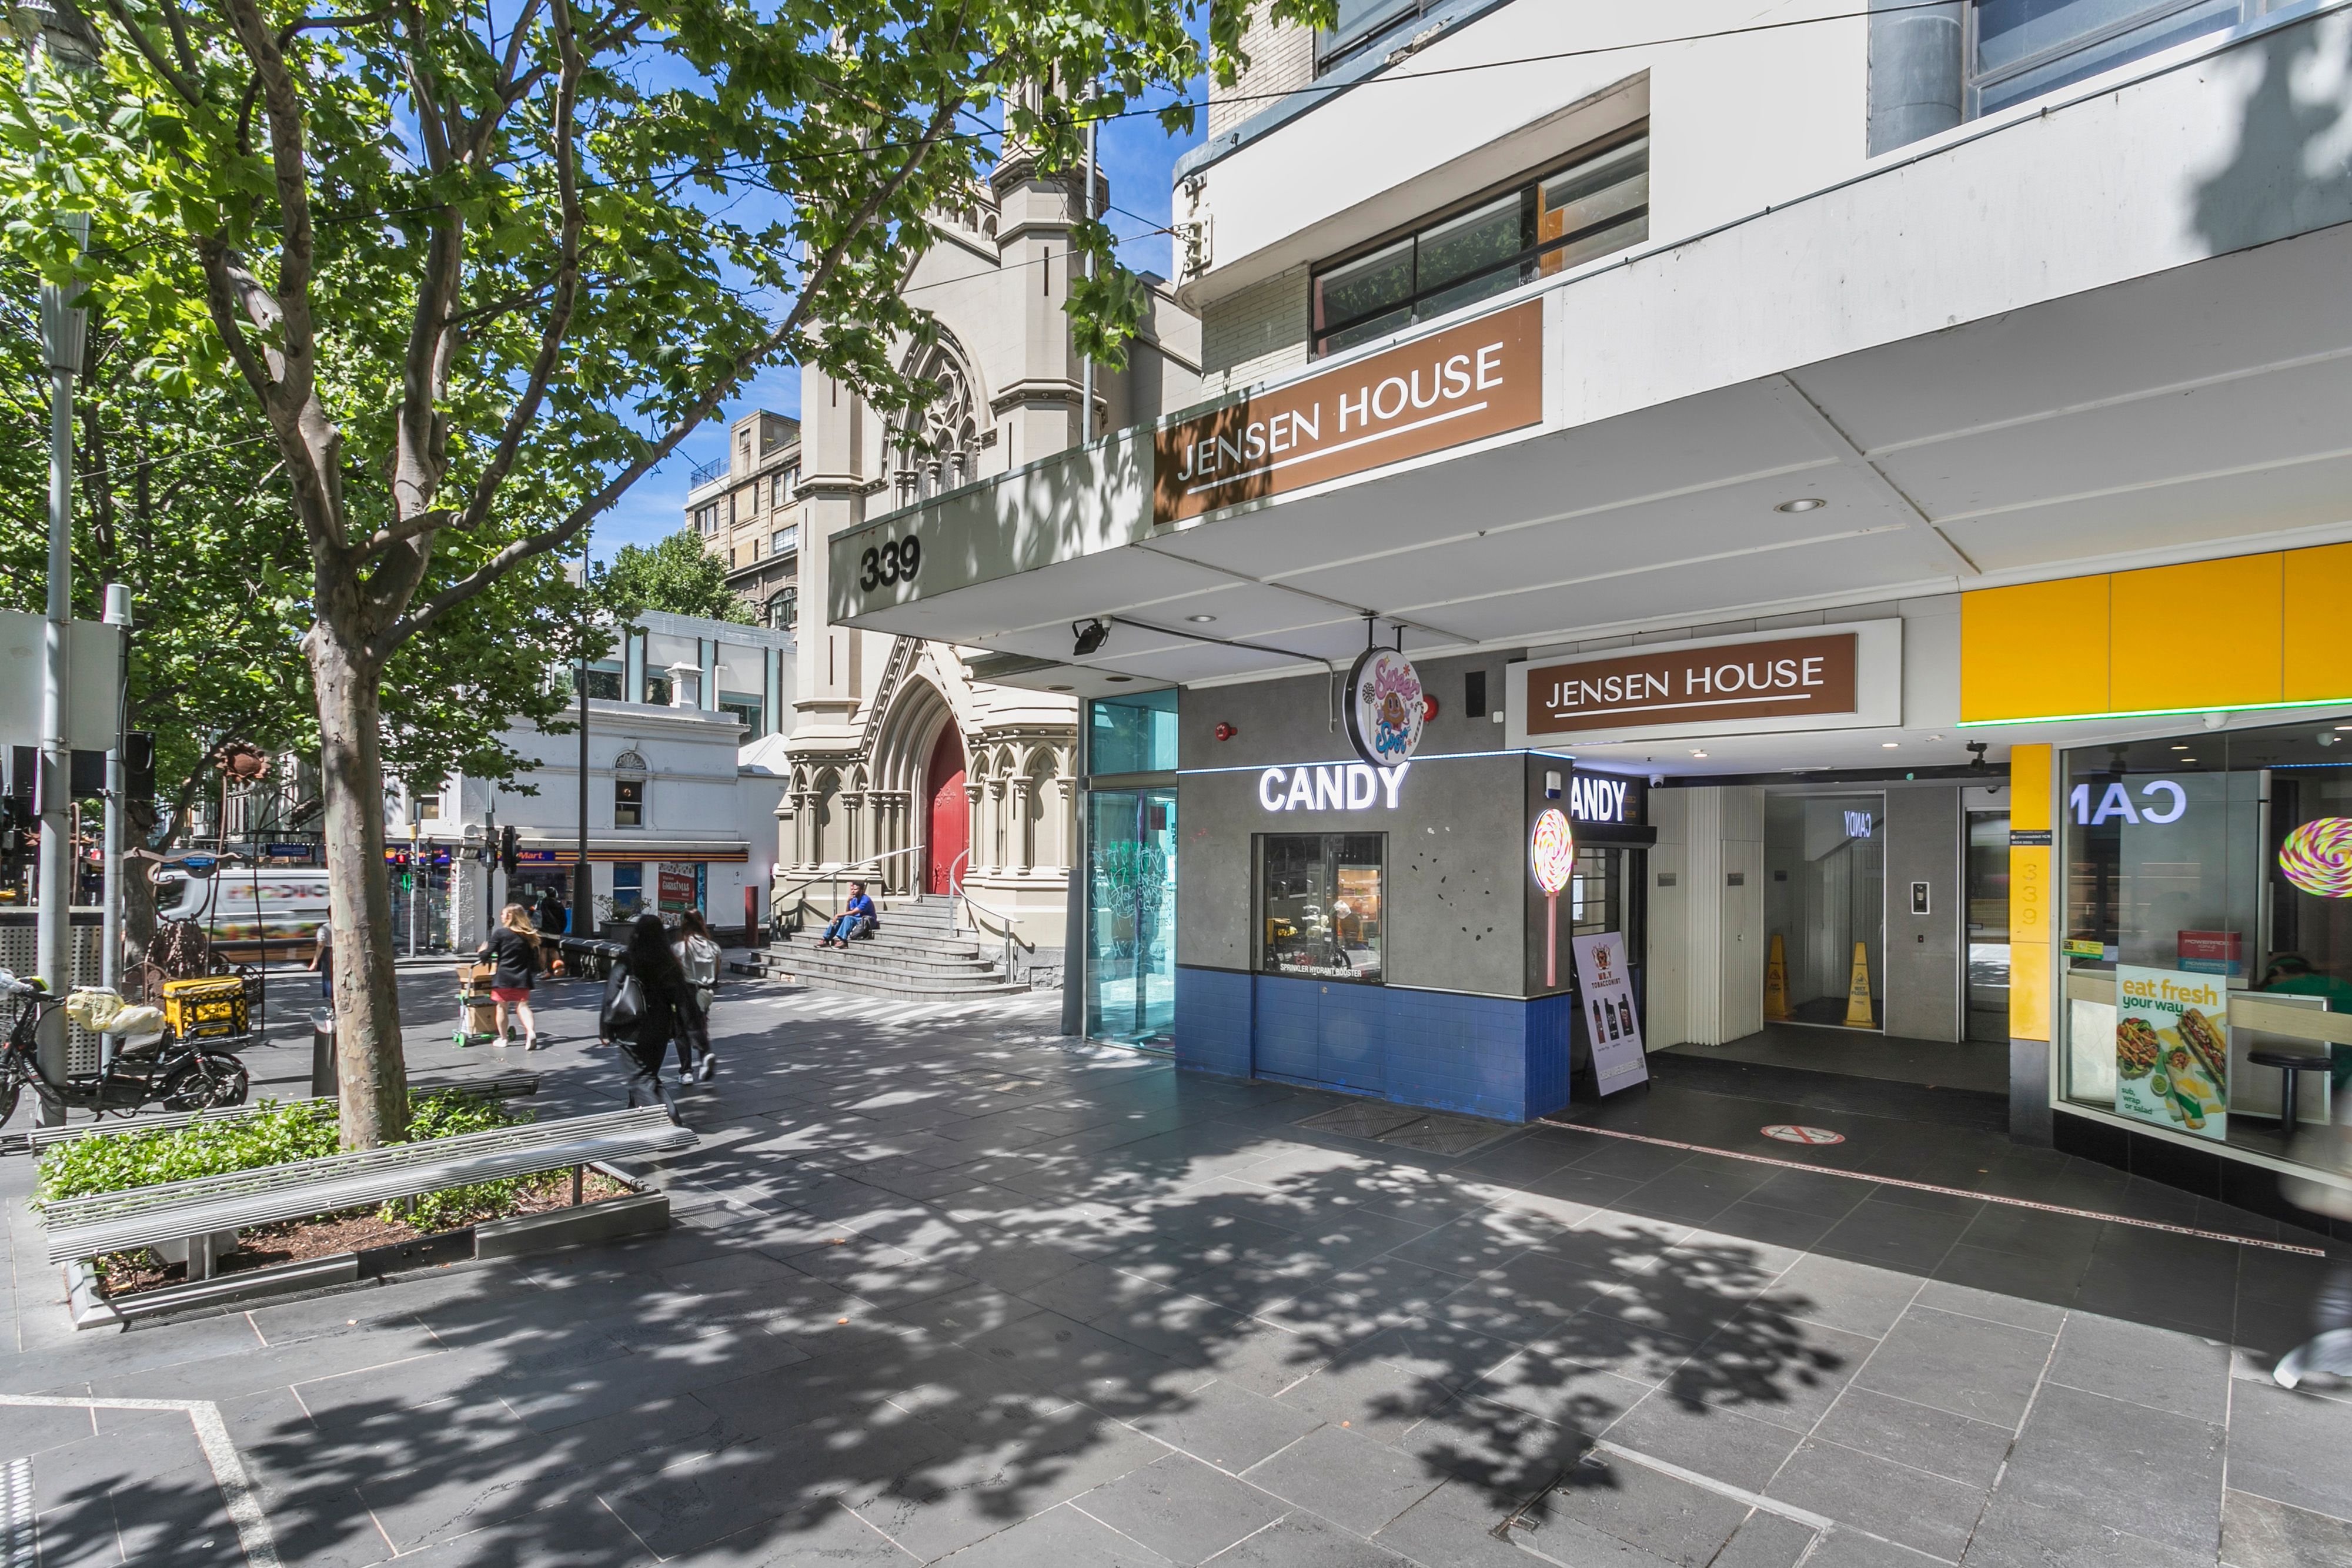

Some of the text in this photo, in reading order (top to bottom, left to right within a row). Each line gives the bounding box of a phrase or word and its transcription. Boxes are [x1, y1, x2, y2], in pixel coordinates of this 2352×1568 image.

[1177, 341, 1504, 482] JENSEN HOUSE
[859, 534, 921, 593] 339
[1546, 656, 1824, 709] JENSEN HOUSE
[1375, 721, 1408, 760] Spot
[1259, 761, 1411, 812] CANDY
[1571, 777, 1626, 821] ANDY
[2022, 863, 2038, 925] 339
[1280, 963, 1362, 978] SPRINKLER HYDRANT BOOSTER
[1591, 978, 1621, 989] TOBACCONIST
[2122, 978, 2218, 1007] eat fresh
[2123, 995, 2184, 1017] your way
[2122, 1088, 2136, 1096] sub,
[2123, 1095, 2141, 1105] wrap
[2134, 1105, 2153, 1115] salad
[1869, 1176, 1927, 1189] SMOKING
[1989, 1196, 2020, 1205] THIS
[2024, 1202, 2059, 1211] LINE
[2085, 1212, 2157, 1228] SMOKING
[2163, 1225, 2230, 1240] BEYOND
[2237, 1238, 2276, 1248] THIS
[2281, 1245, 2323, 1256] LINE
